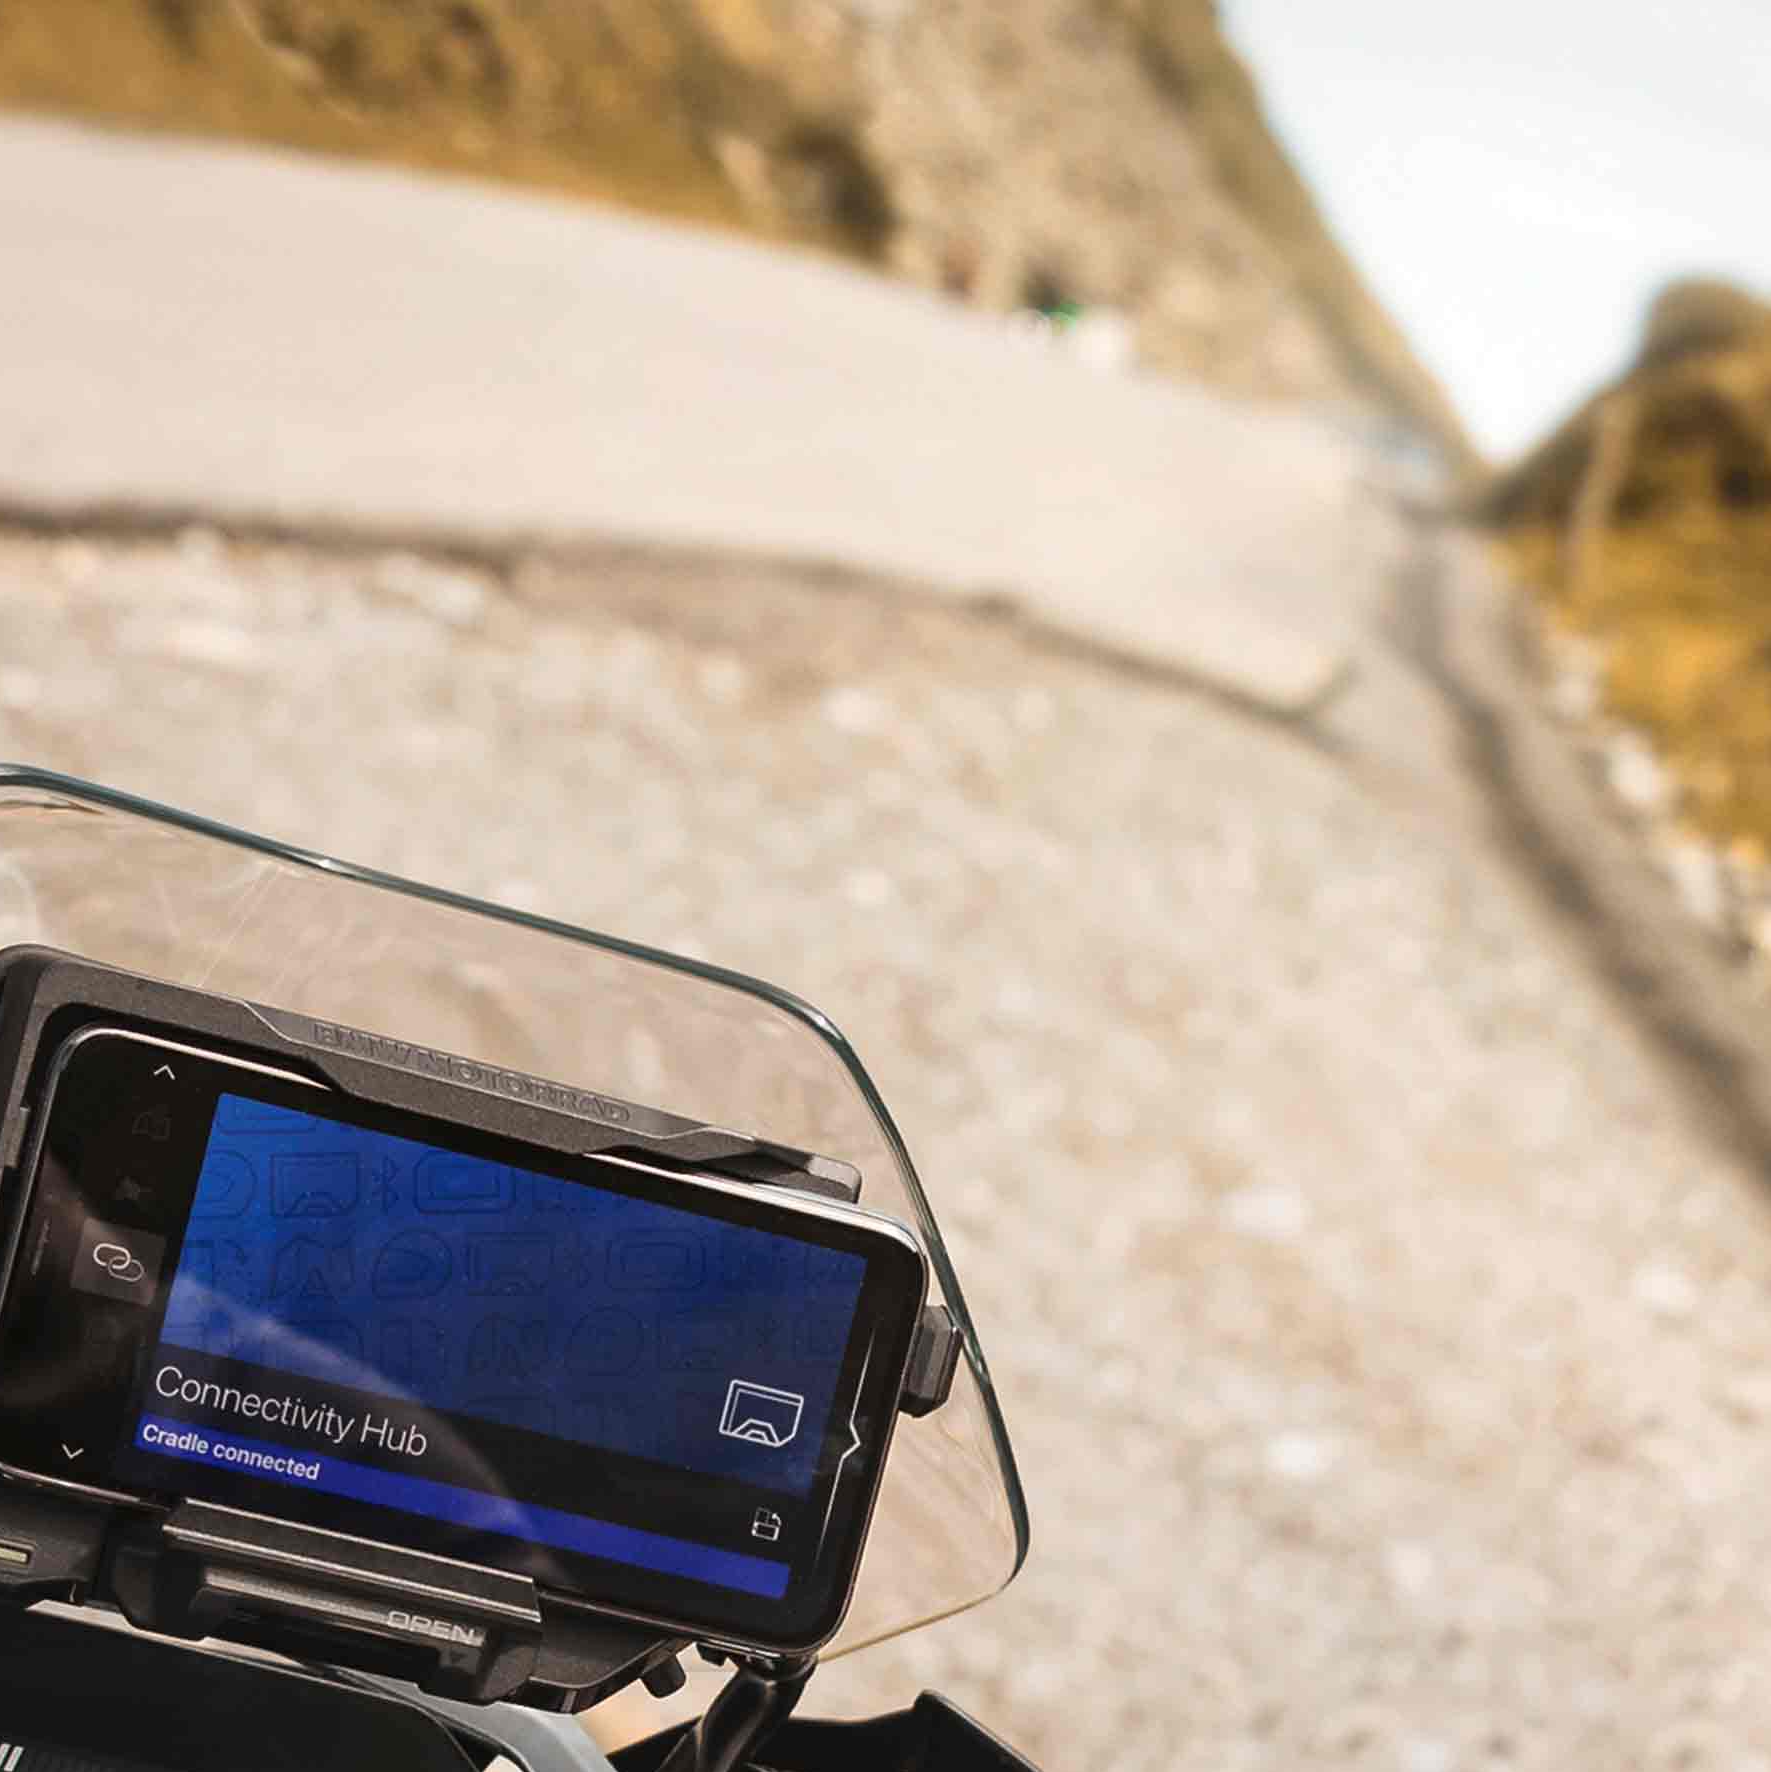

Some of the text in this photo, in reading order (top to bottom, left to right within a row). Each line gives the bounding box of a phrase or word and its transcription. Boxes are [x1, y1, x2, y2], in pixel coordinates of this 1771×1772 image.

[314, 1023, 411, 1066] BMW
[155, 1366, 427, 1456] Connectivity Hub
[142, 1424, 320, 1480] Cradle connected
[388, 1610, 475, 1645] OPEN
